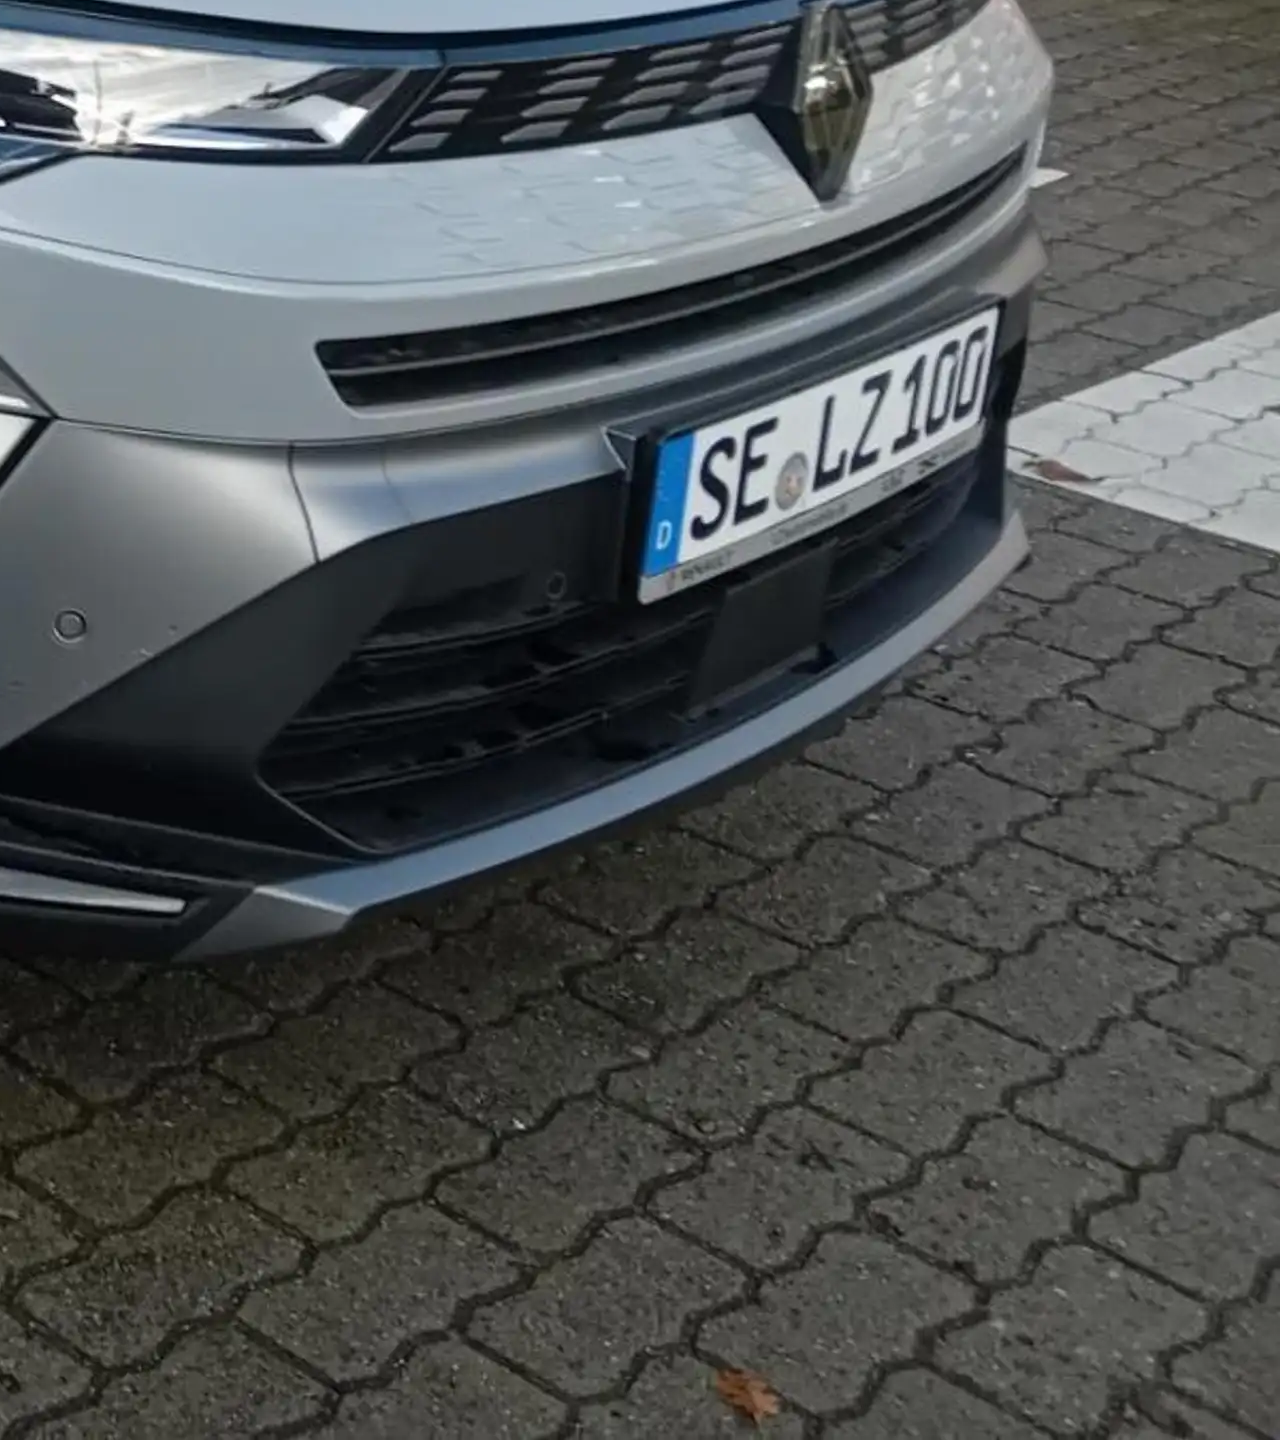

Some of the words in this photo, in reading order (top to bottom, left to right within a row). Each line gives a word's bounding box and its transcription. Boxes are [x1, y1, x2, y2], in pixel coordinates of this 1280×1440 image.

[656, 520, 672, 550] D
[690, 417, 780, 542] SE
[811, 369, 894, 493] LZ
[891, 325, 990, 455] 100
